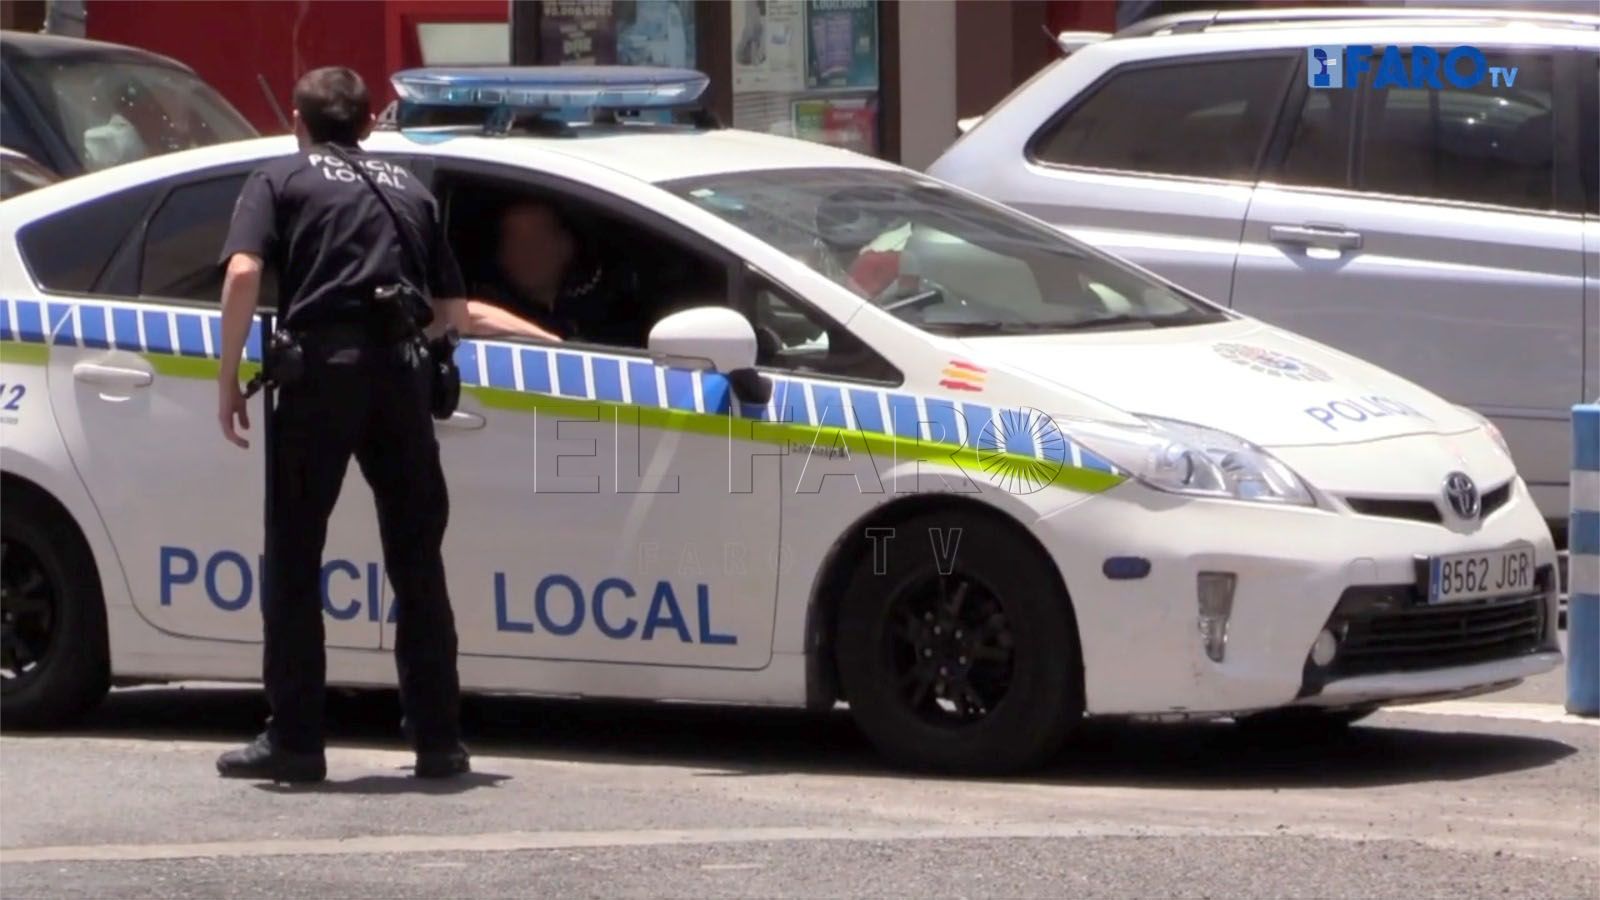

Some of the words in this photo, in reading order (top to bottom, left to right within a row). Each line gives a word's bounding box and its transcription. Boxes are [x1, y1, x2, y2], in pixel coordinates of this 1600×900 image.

[159, 545, 399, 624] POCI
[494, 571, 738, 646] LOCAL
[1441, 558, 1489, 595] 8562
[1496, 552, 1529, 589] JGR
